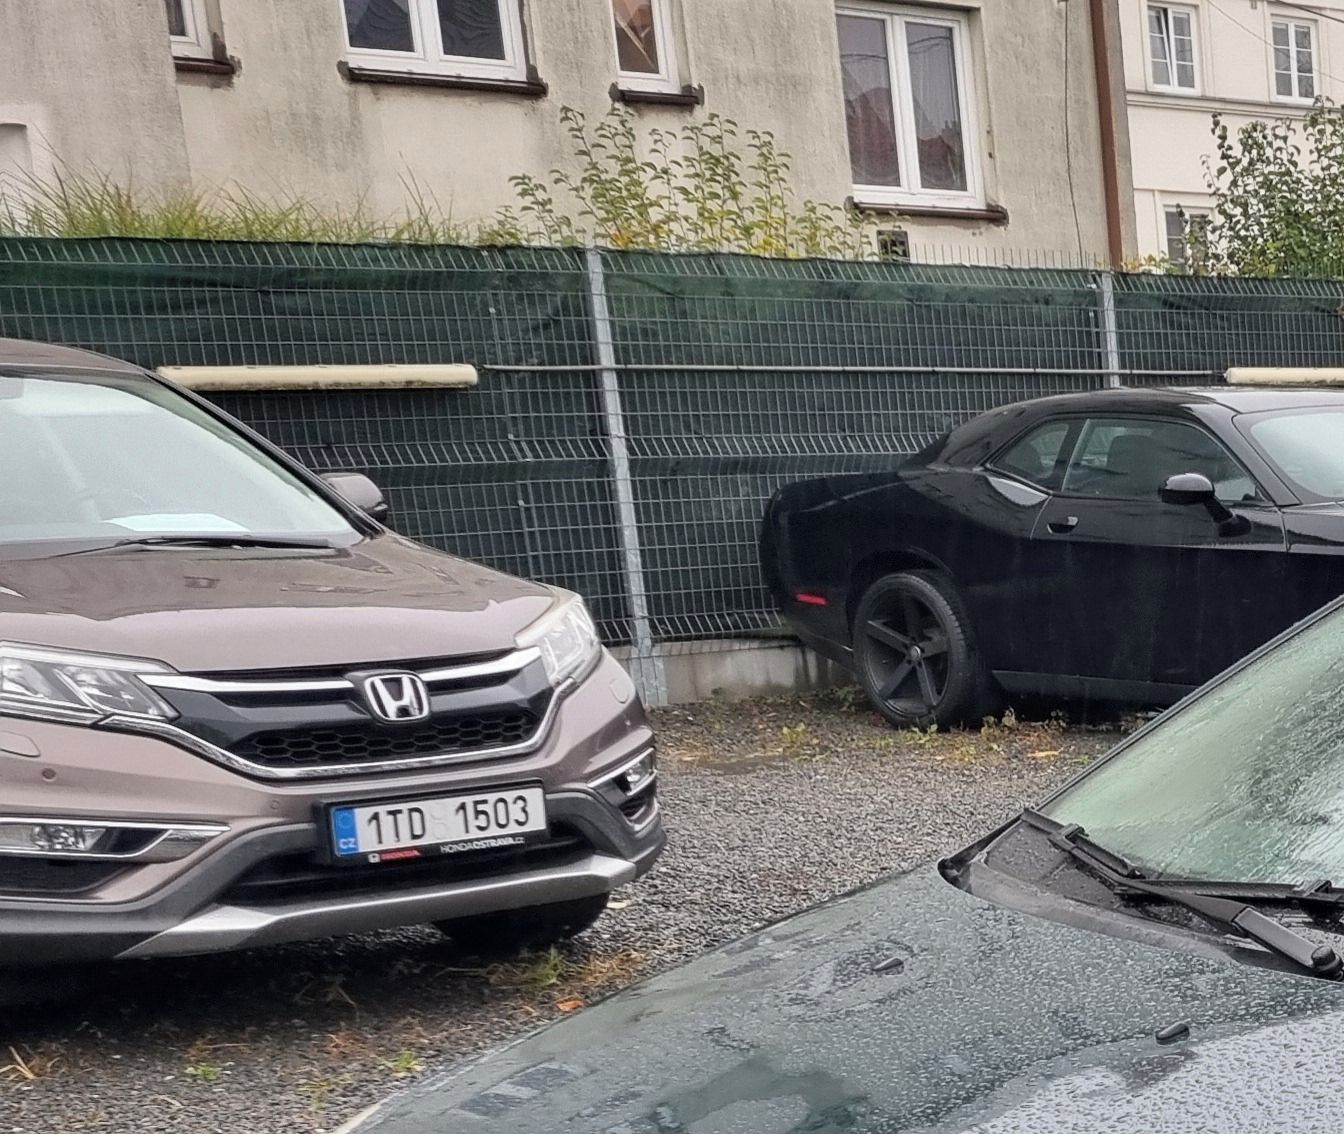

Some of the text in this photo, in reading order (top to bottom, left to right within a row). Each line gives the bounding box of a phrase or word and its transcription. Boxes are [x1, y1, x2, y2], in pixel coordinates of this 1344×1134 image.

[367, 794, 530, 845] 1TD 1503
[339, 838, 357, 850] CZ
